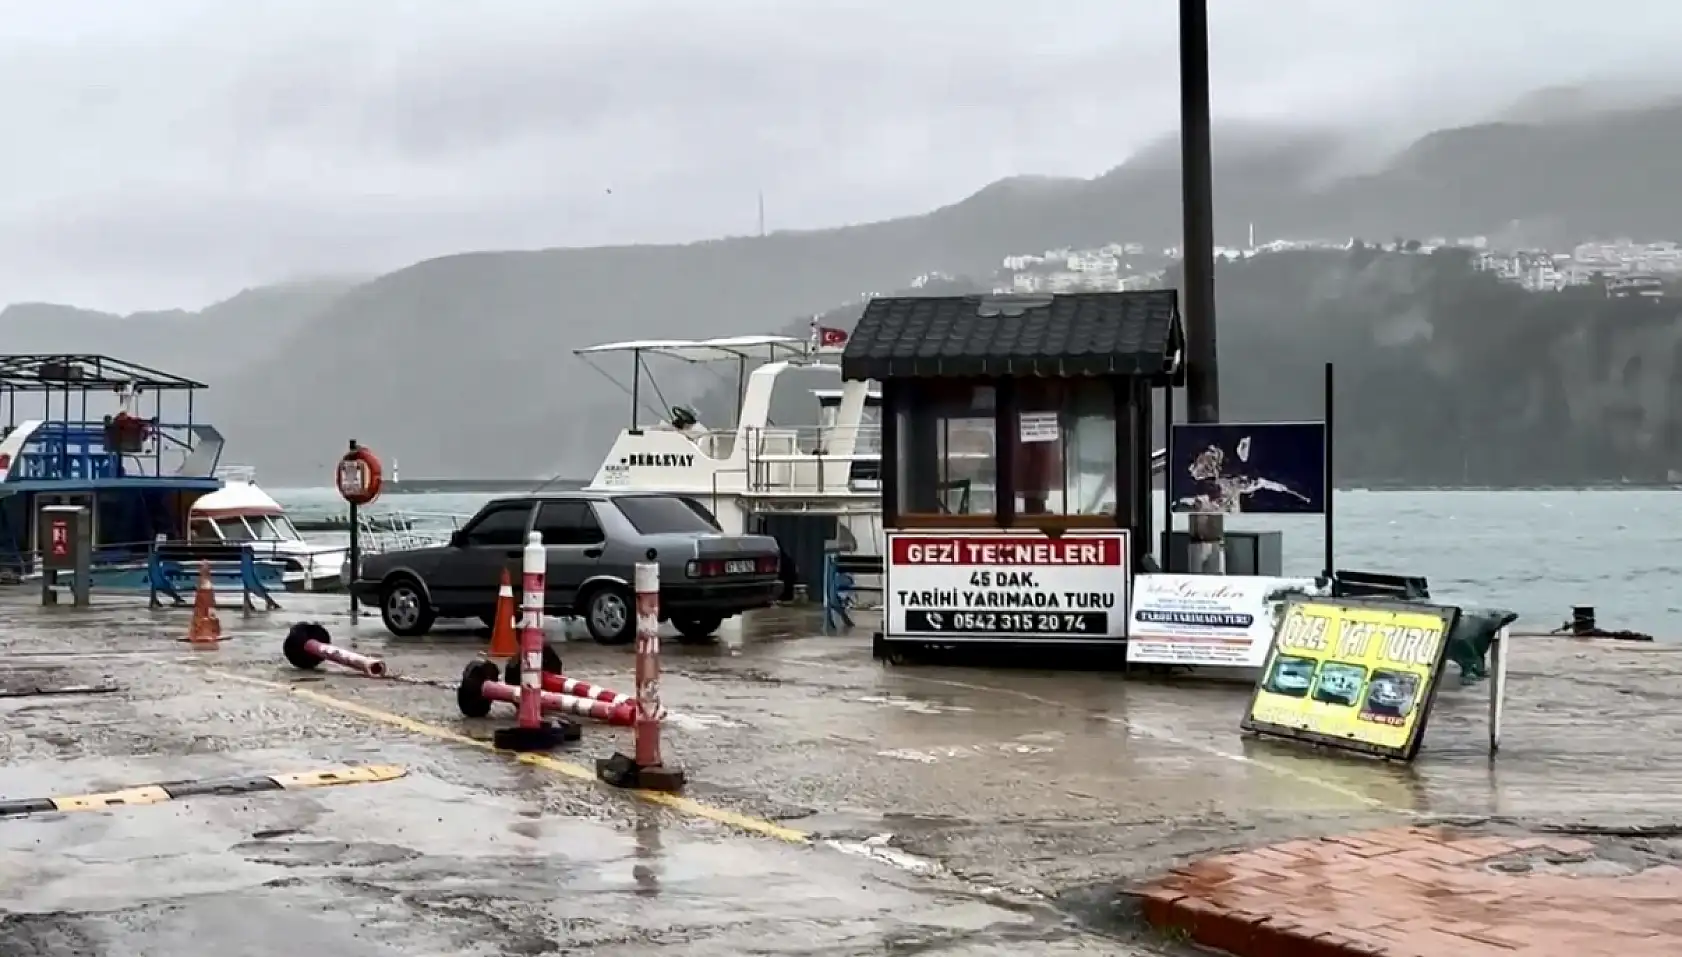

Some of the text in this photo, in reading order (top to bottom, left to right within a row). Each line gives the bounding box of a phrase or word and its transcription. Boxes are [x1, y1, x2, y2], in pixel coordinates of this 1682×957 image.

[908, 540, 960, 563] GEZİ
[970, 571, 1039, 587] 45 DAK.
[898, 587, 1115, 608] TARİHİ YARIMADA TURU
[953, 614, 1086, 630] 0542 315 20 74
[1333, 618, 1381, 659] YAT
[1378, 624, 1441, 665] TURU
